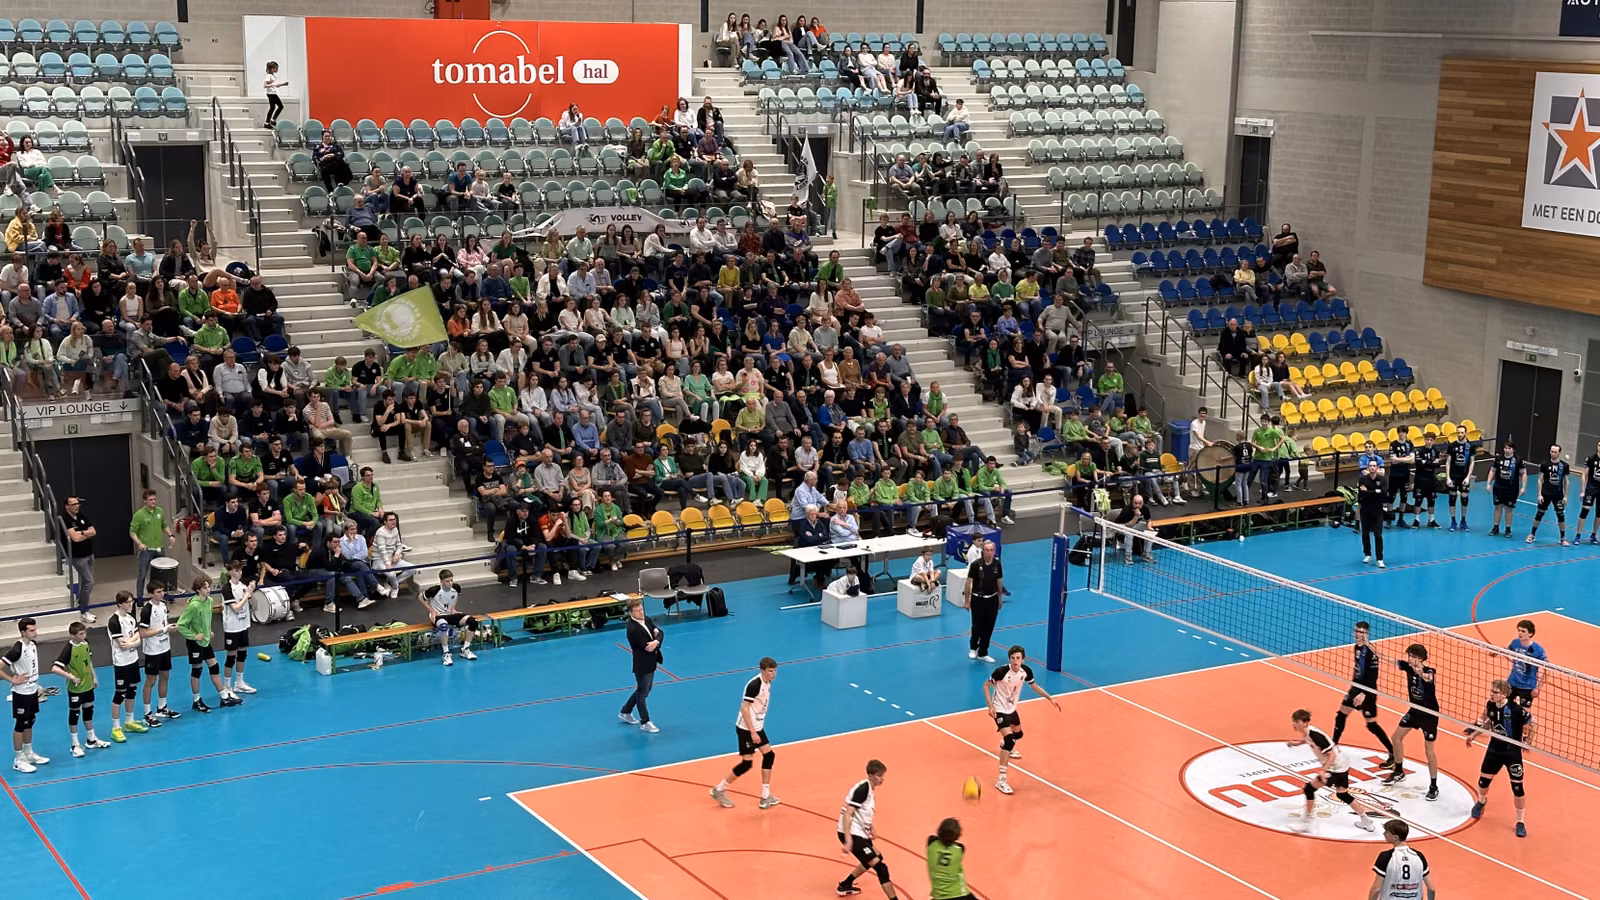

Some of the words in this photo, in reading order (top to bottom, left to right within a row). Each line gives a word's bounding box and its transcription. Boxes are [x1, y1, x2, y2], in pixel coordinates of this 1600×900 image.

[432, 55, 566, 84] tomabel
[583, 64, 608, 79] hal
[611, 214, 642, 222] VOLLEY
[1532, 204, 1558, 218] MET
[1561, 207, 1584, 222] EEN
[36, 406, 56, 416] VIP
[59, 402, 110, 414] LOUNGE
[936, 851, 952, 866] 15
[1402, 864, 1410, 879] 8
